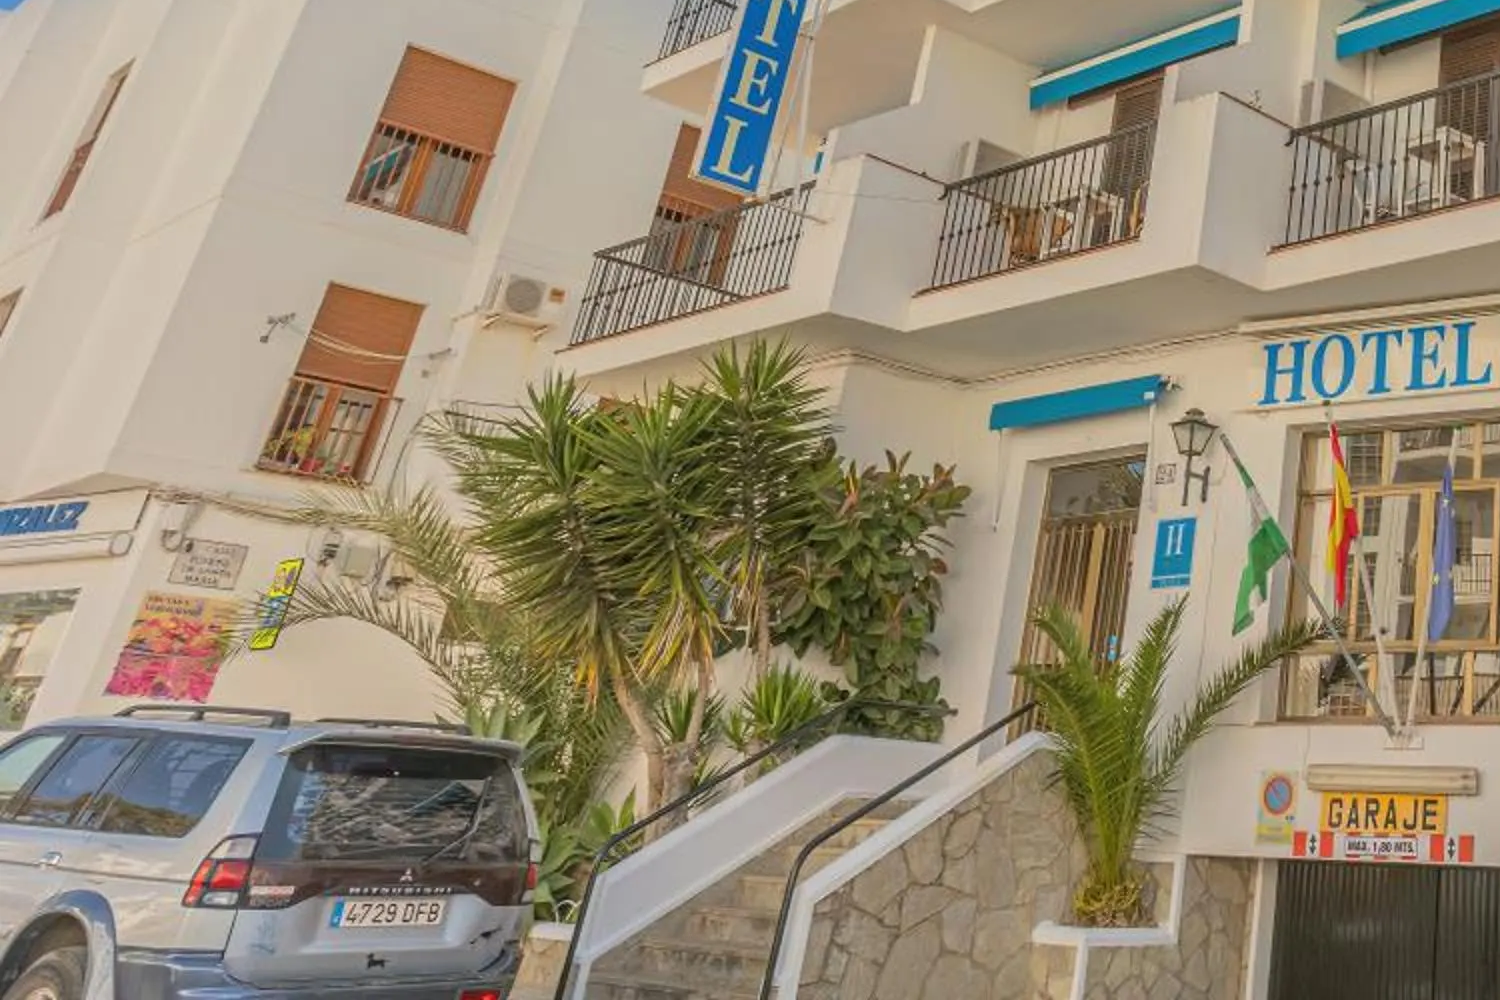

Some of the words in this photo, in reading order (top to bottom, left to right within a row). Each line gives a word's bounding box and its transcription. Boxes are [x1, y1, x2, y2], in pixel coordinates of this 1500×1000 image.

[1256, 321, 1493, 406] HOTEL
[1327, 797, 1440, 831] GARAJE
[346, 903, 399, 924] 4729
[402, 902, 442, 923] DFB
